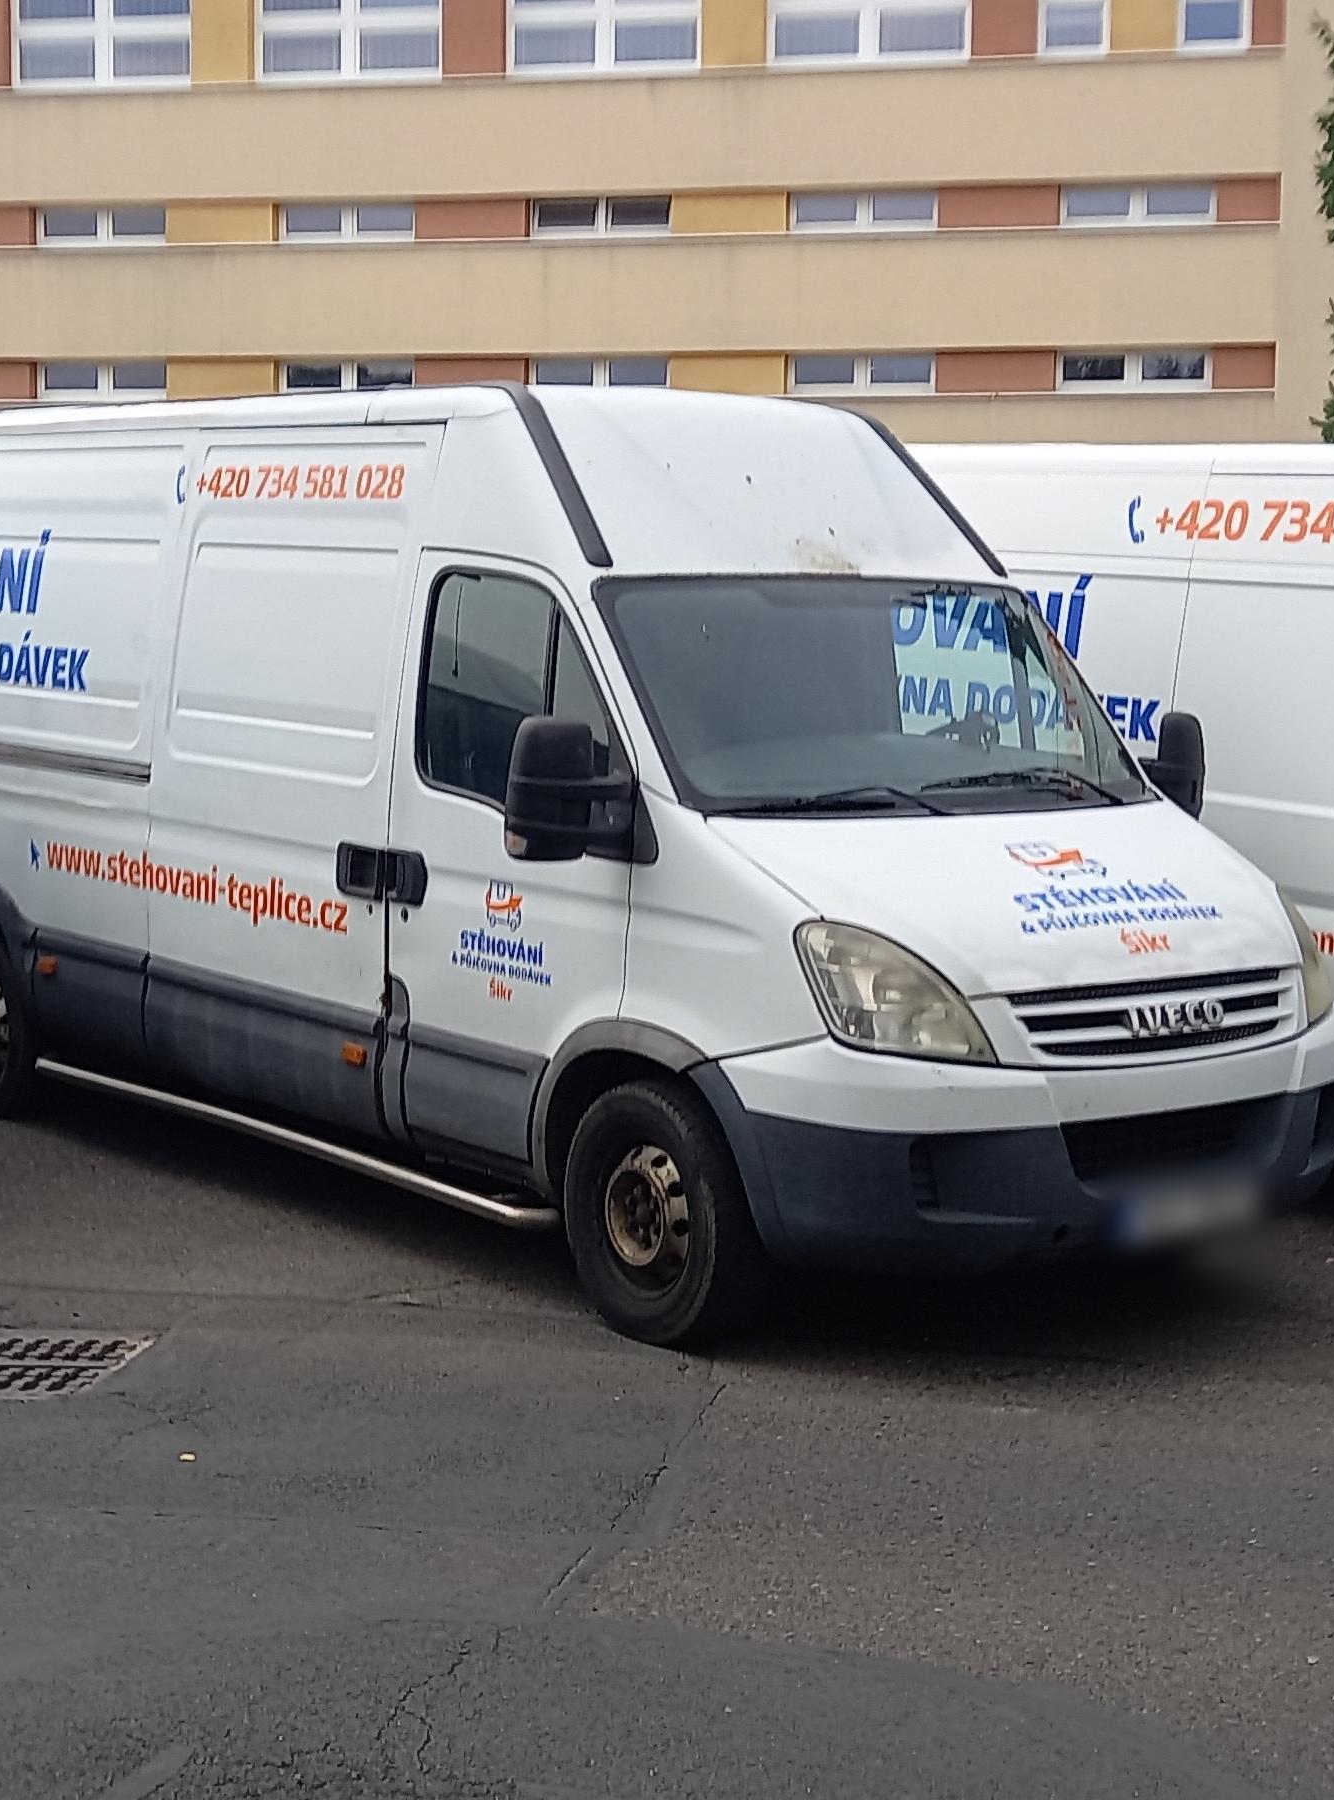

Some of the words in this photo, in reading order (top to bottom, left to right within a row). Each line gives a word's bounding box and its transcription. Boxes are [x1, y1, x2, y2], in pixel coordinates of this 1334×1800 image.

[196, 464, 250, 499] +420
[255, 464, 300, 499] 734
[303, 464, 349, 499] 581
[355, 463, 406, 499] 028
[1155, 500, 1250, 541] +420
[46, 840, 349, 936] www.stehovani-teplice.cz
[460, 928, 544, 968] STĚHOVÁNÍ
[508, 963, 552, 988] DODÁVEK
[1123, 1000, 1225, 1038] IVECO
